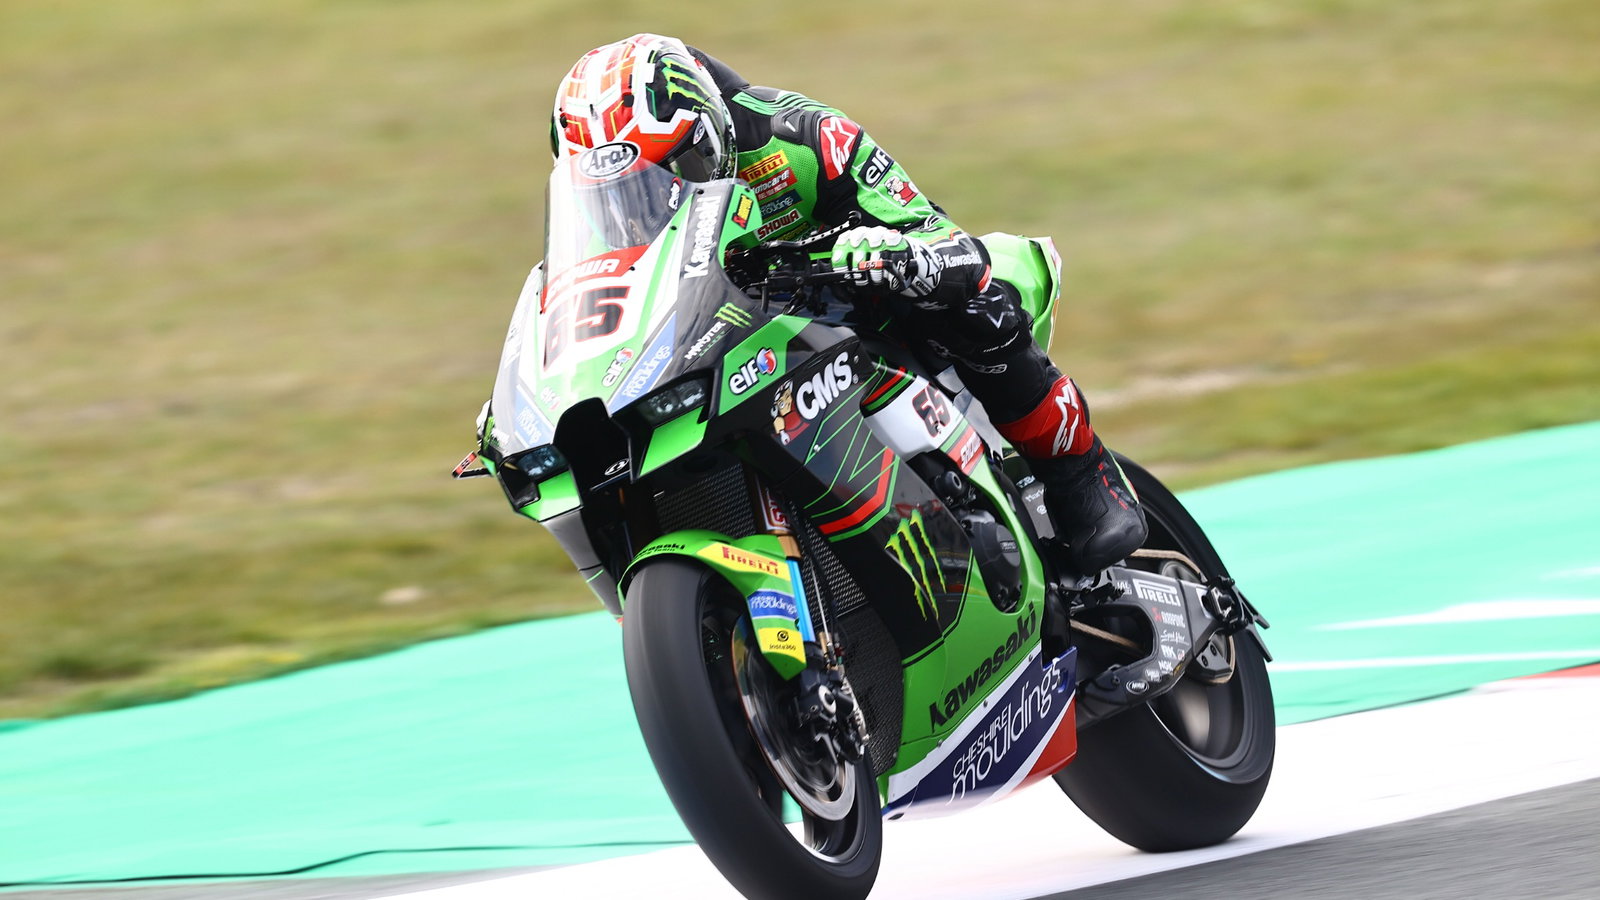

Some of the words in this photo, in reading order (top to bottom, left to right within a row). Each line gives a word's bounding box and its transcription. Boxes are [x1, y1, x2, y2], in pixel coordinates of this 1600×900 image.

[586, 147, 630, 173] Arai
[865, 148, 892, 184] elf
[683, 195, 722, 280] Kawasaki
[757, 209, 800, 239] SHOWA
[943, 250, 983, 269] Kawasaki
[543, 285, 631, 373] 65
[684, 320, 727, 360] MONSTER
[729, 360, 759, 395] elf
[796, 351, 853, 420] CMS
[911, 384, 951, 438] 65
[1132, 578, 1181, 607] PIRELLI
[929, 602, 1037, 734] Kawasaki
[945, 657, 1062, 806] mouldings
[952, 709, 1008, 779] CHESHIRE
